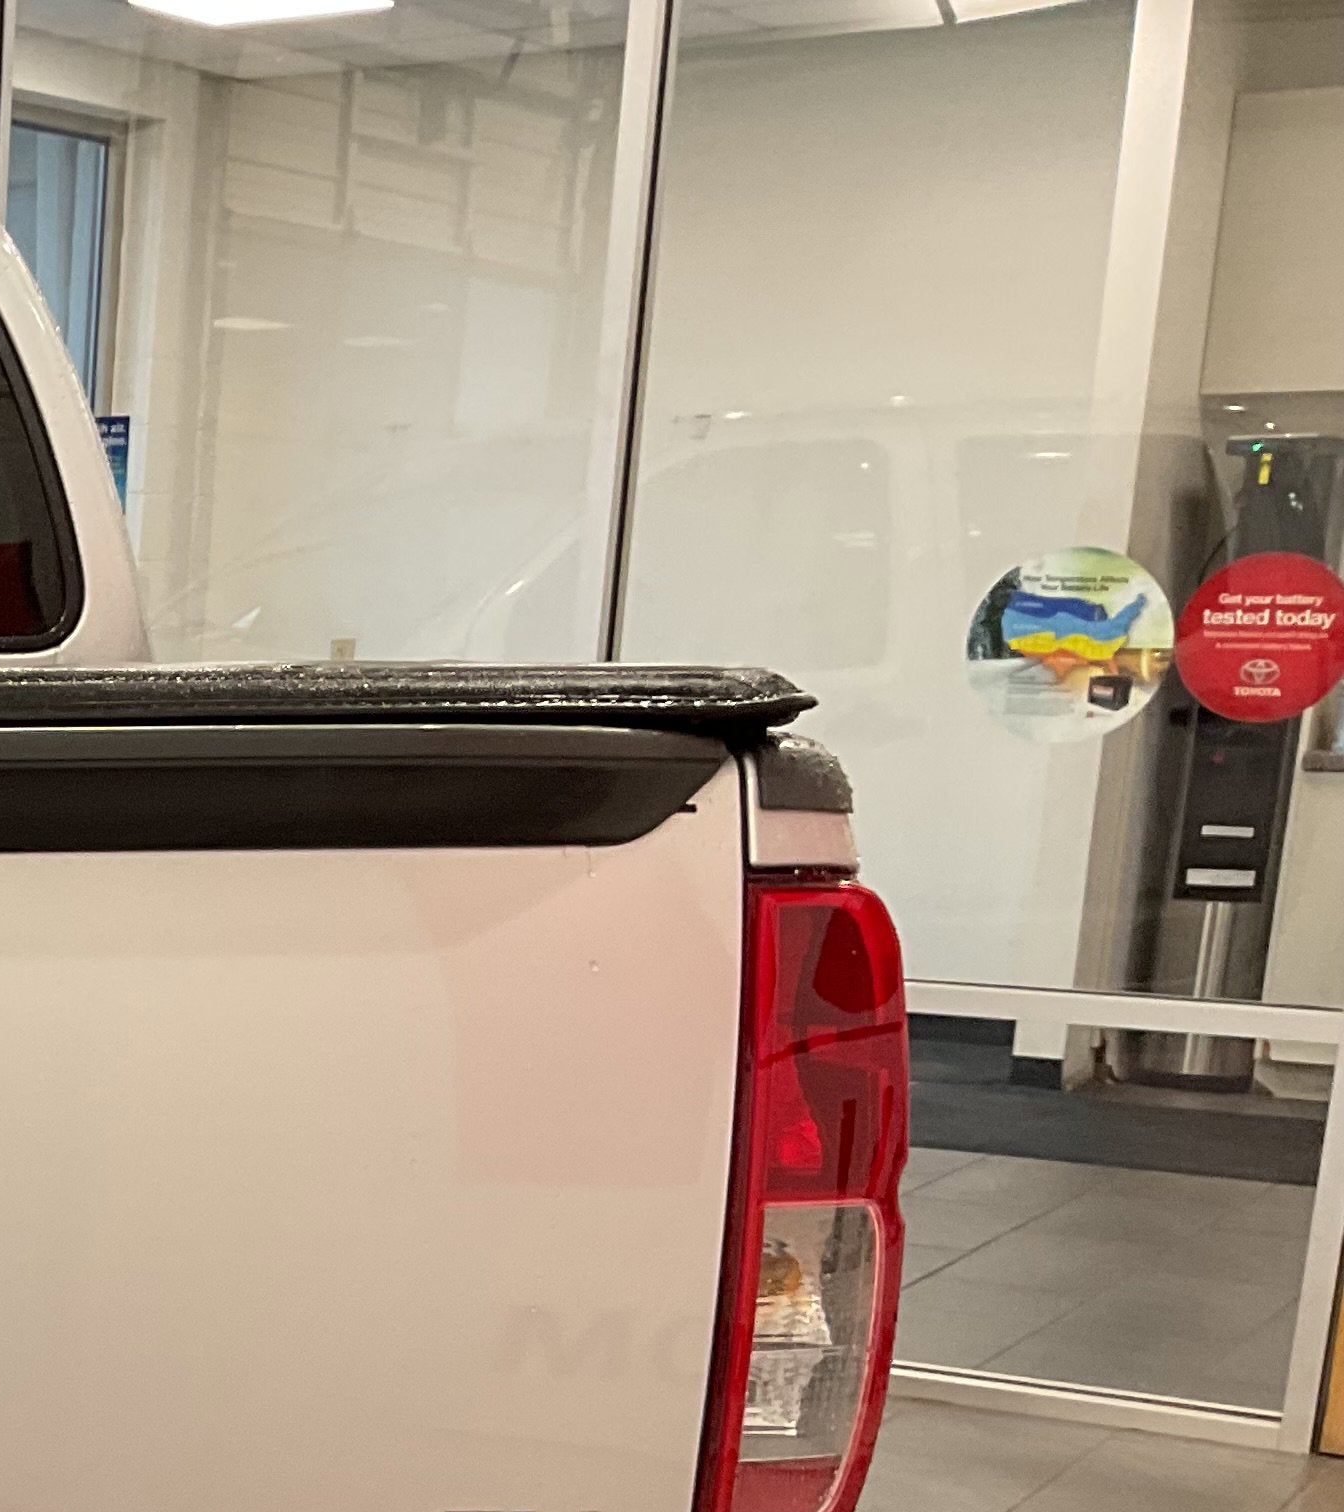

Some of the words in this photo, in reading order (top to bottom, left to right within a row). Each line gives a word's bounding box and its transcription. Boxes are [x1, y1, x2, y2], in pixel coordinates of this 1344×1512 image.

[1218, 592, 1242, 604] Get
[1244, 595, 1274, 606] your
[1275, 594, 1324, 606] battery
[1203, 609, 1270, 625] tested
[1275, 609, 1336, 630] today
[1232, 686, 1282, 697] TOYOTA
